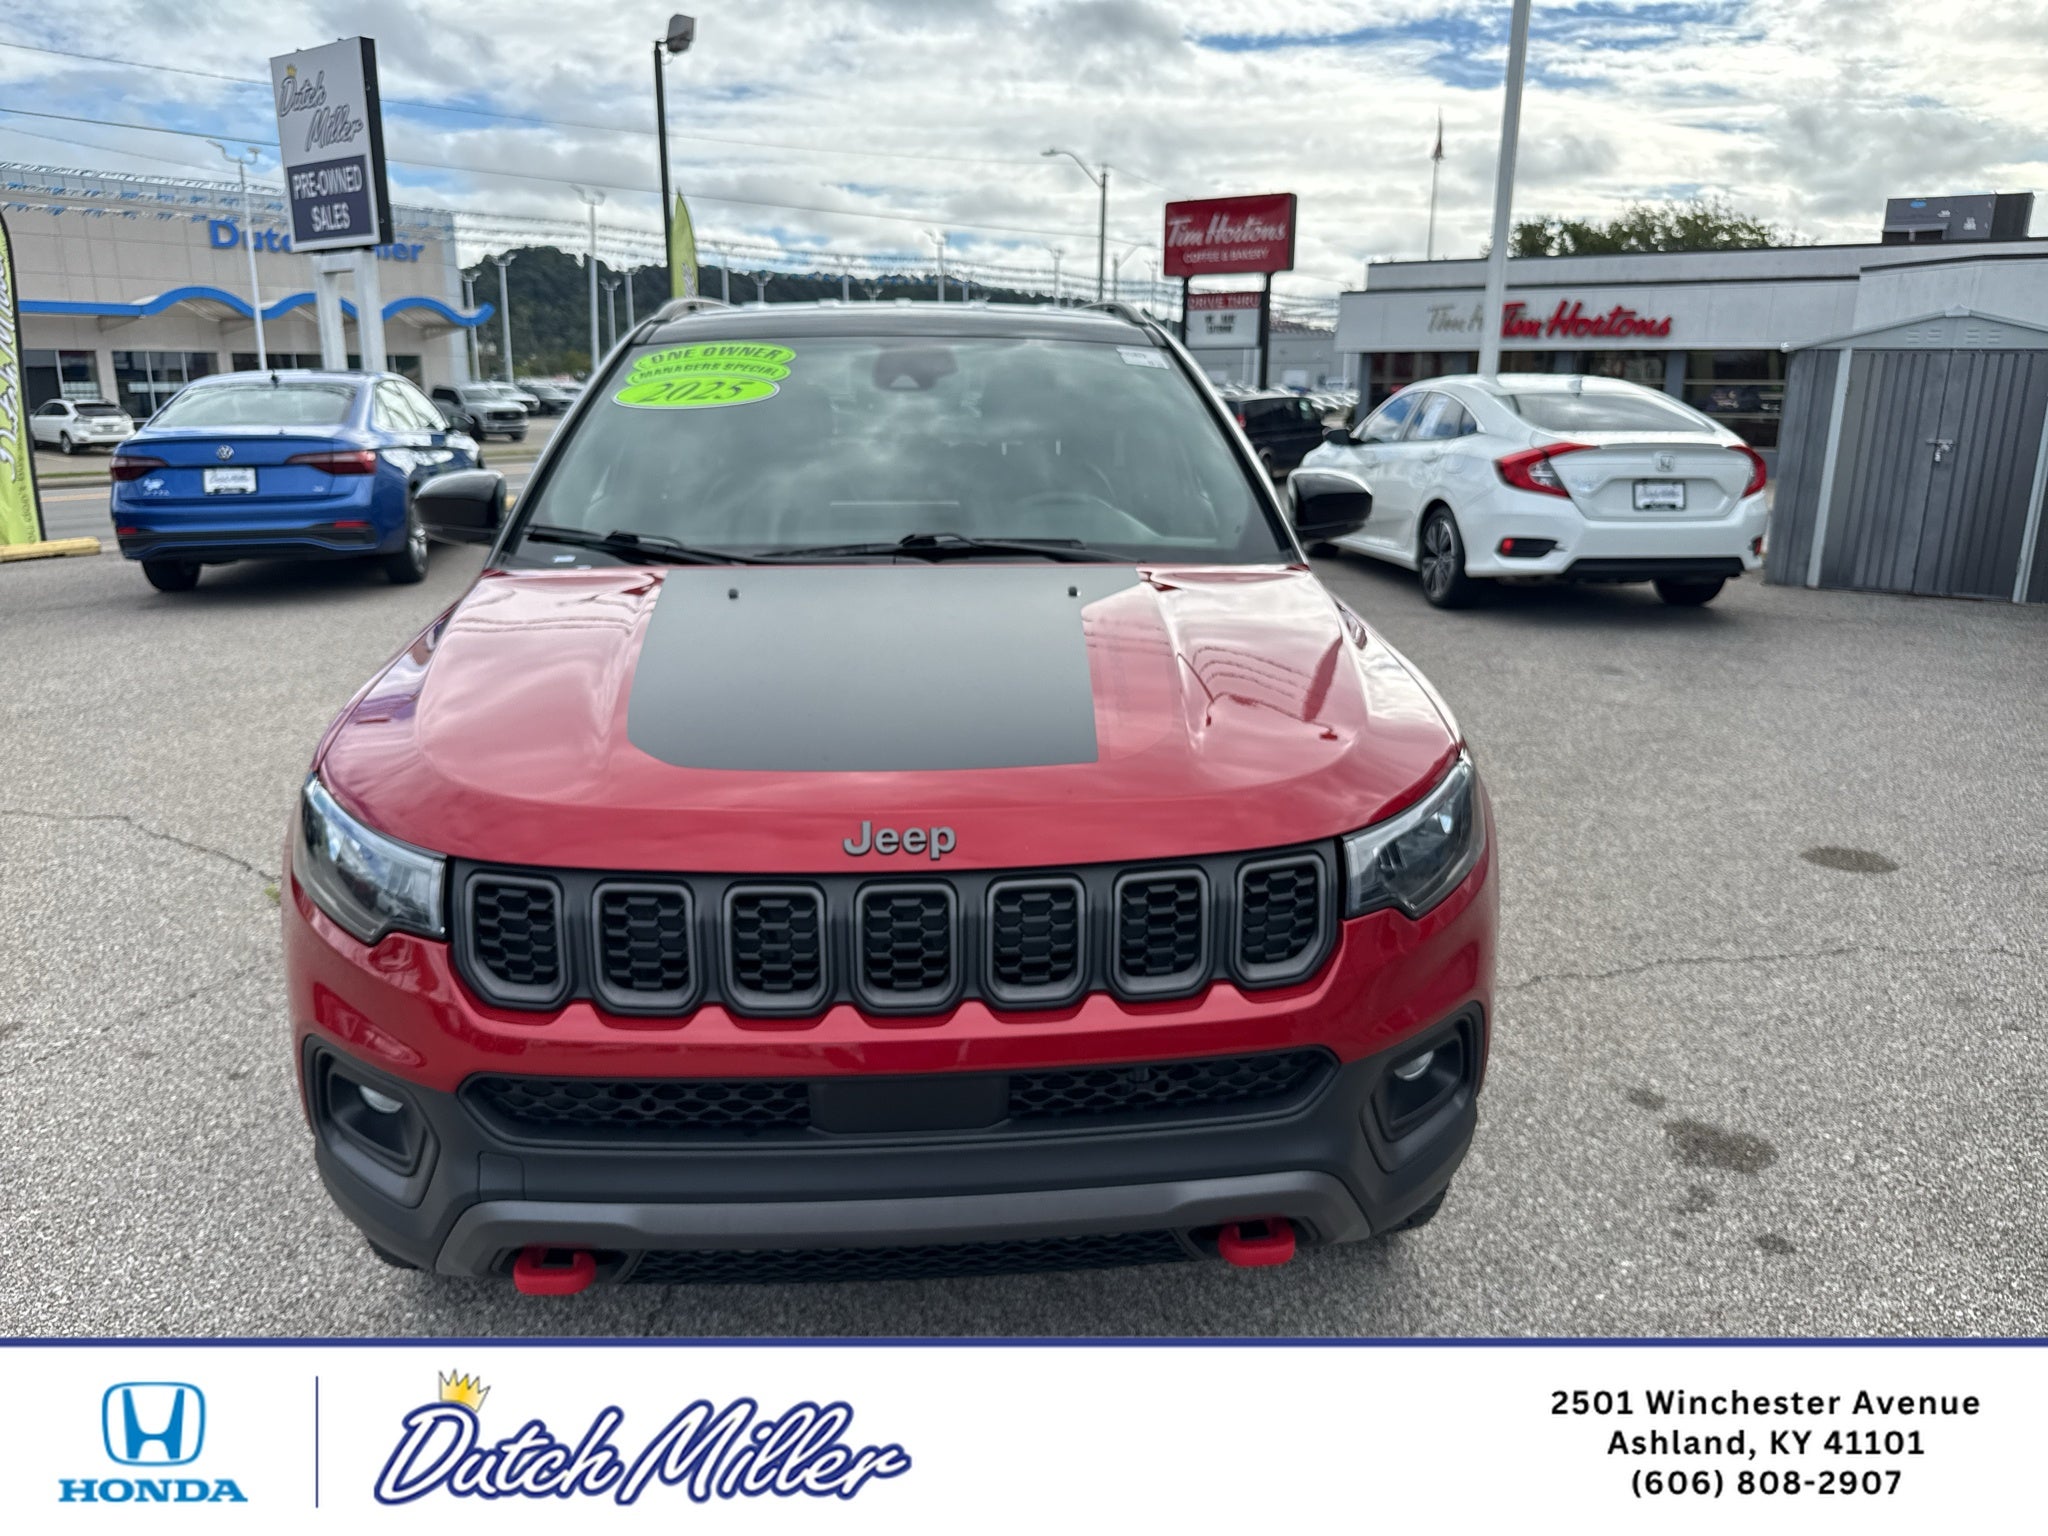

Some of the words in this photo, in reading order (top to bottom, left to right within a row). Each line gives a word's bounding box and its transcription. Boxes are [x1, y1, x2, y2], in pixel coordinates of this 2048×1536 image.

[280, 70, 327, 117] Dutch
[305, 104, 364, 152] Miller
[292, 164, 363, 200] PRE-OWNED
[310, 202, 351, 232] SALES
[1167, 214, 1204, 248] Tim
[1205, 212, 1287, 245] Hortons
[1187, 295, 1225, 309] DRIVE
[1227, 293, 1261, 308] THRU
[1502, 301, 1542, 338] Tim
[1546, 300, 1672, 338] Hortons
[639, 361, 722, 379] MANAGERS
[723, 362, 780, 377] SPECIAL
[651, 349, 695, 365] ONE
[703, 345, 784, 361] OWNER
[635, 380, 755, 403] 2025
[843, 820, 957, 861] Jeep
